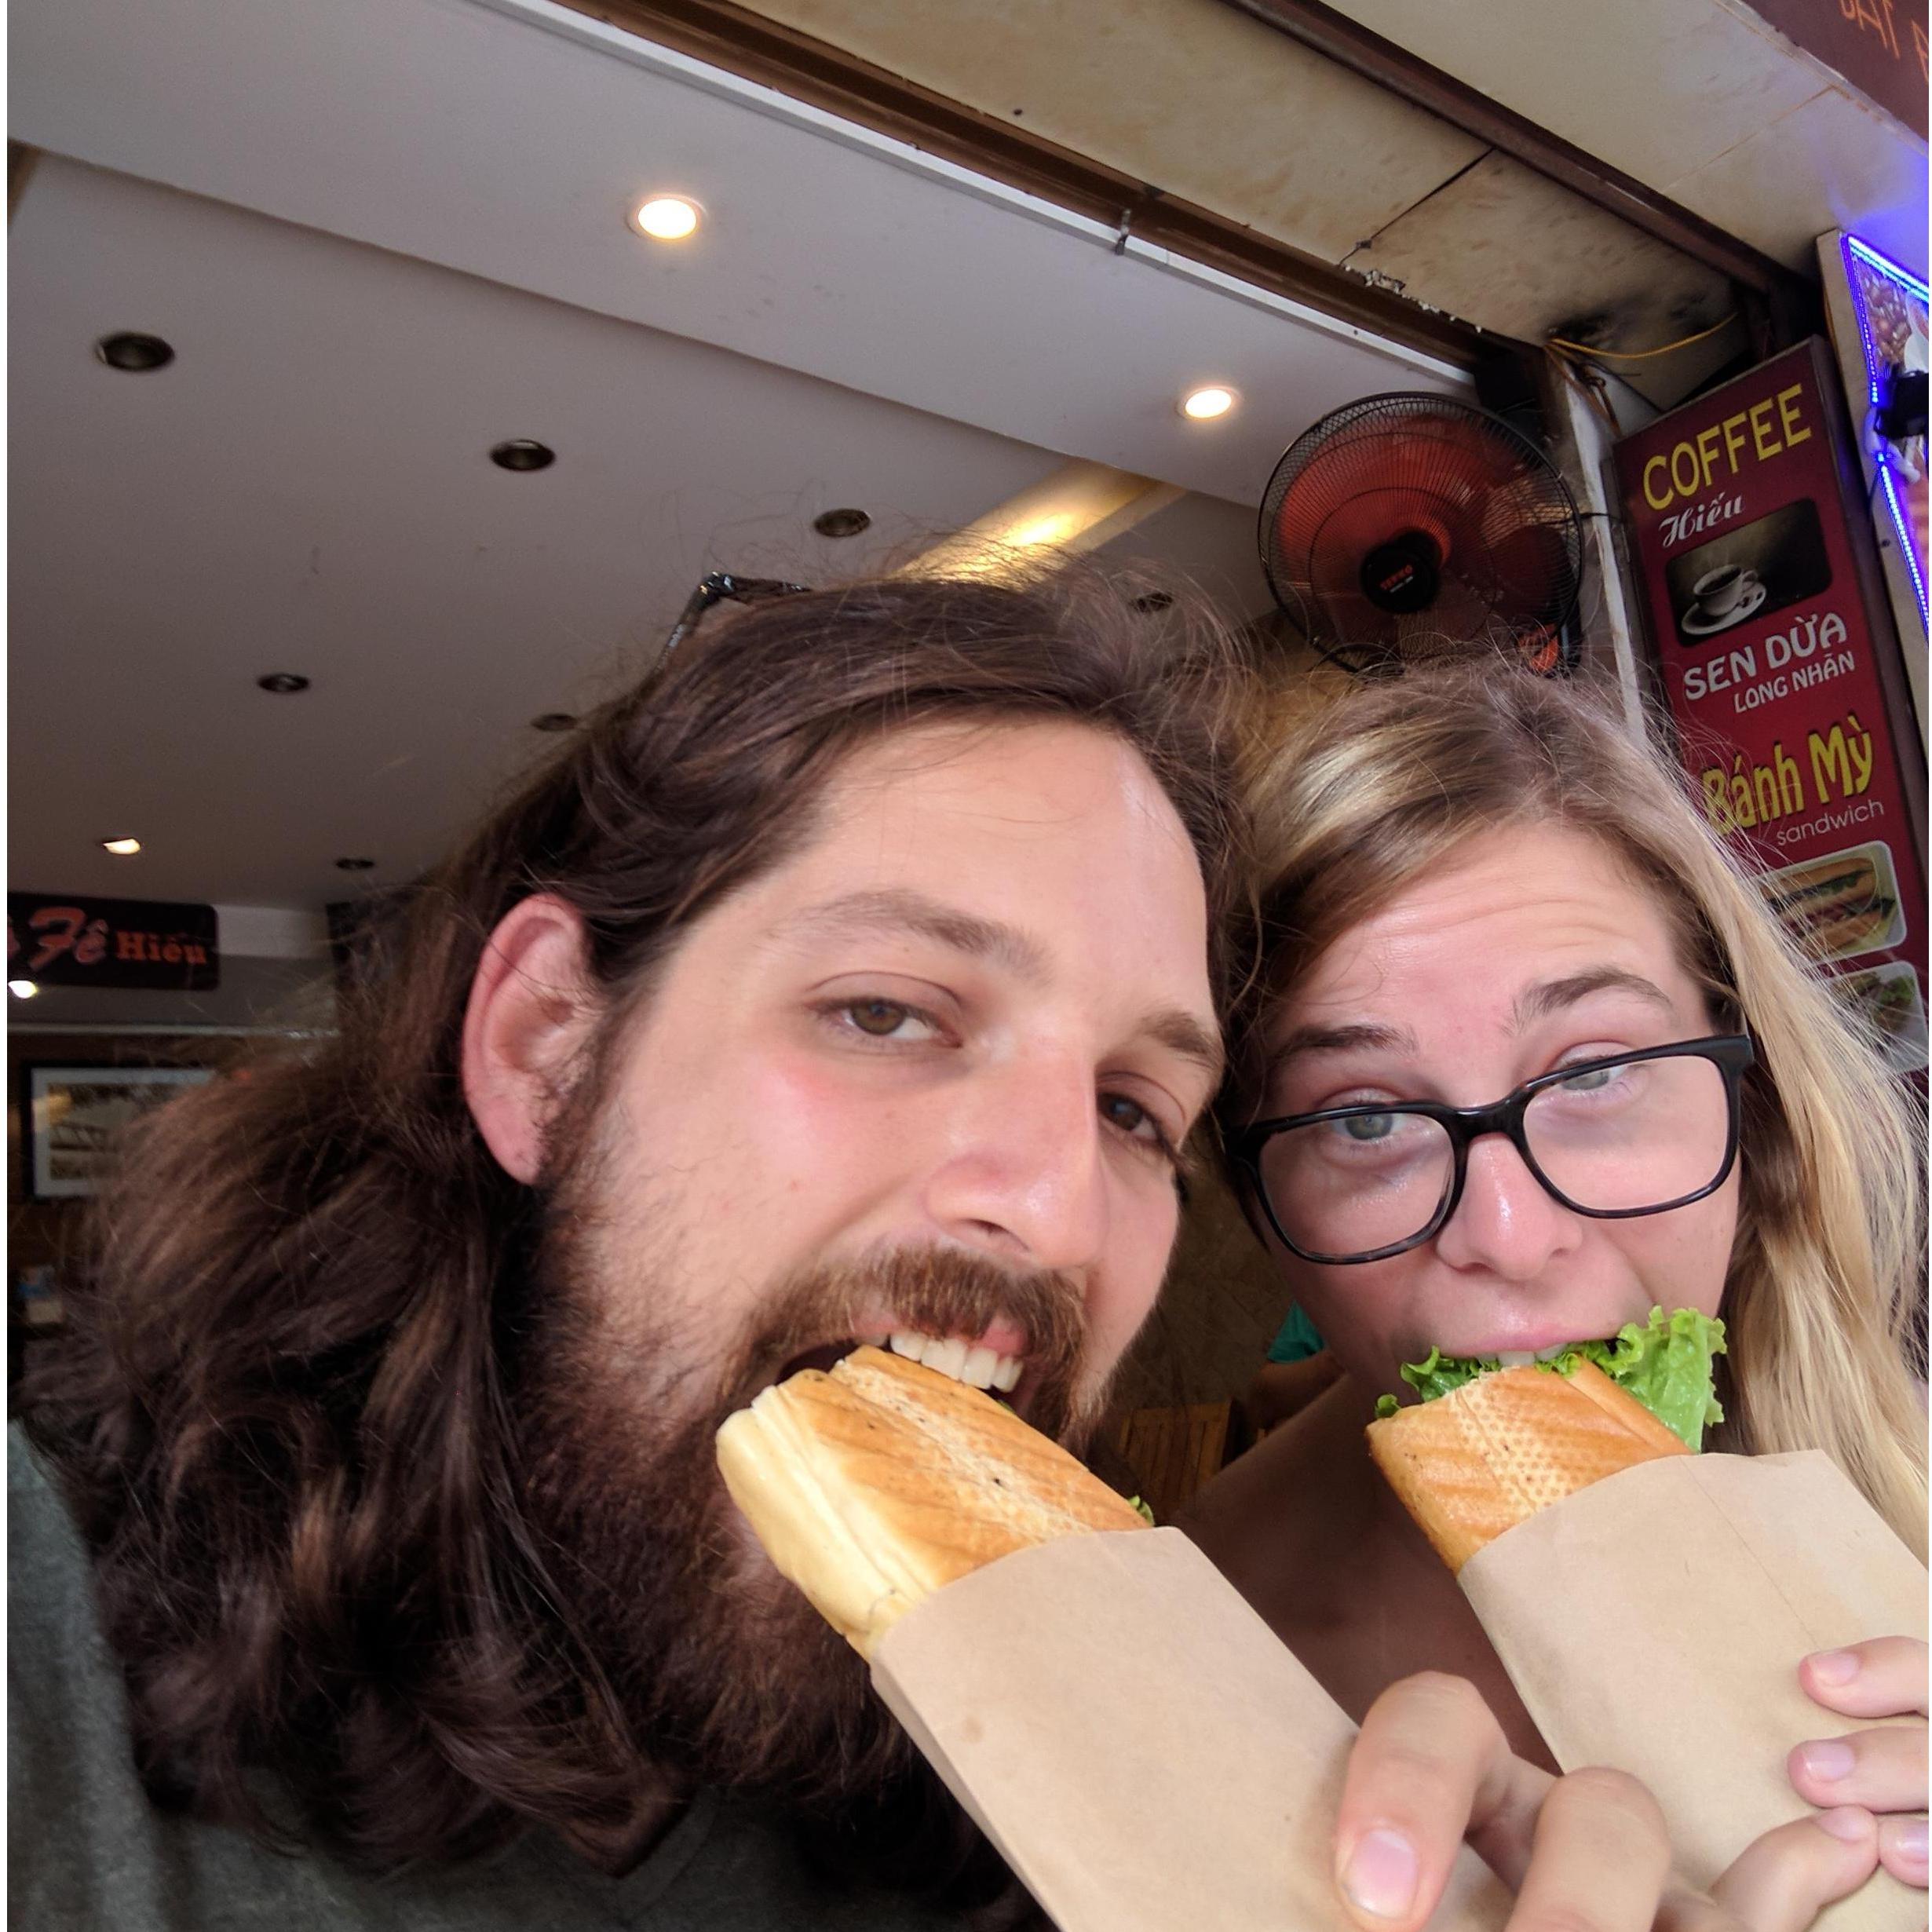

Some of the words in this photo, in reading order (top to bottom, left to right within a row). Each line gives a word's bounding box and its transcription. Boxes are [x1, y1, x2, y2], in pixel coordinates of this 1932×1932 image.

[1643, 383, 1812, 510] COFFEE
[1658, 491, 1745, 548] Hiếu
[1683, 645, 1758, 701] SEN
[1765, 612, 1848, 670] DỪA
[1733, 675, 1789, 714] LONG
[1791, 650, 1856, 692] NHÃN
[1700, 740, 1805, 836] Bánh
[1808, 715, 1874, 805] Mỳ
[1777, 798, 1885, 847] sandwich
